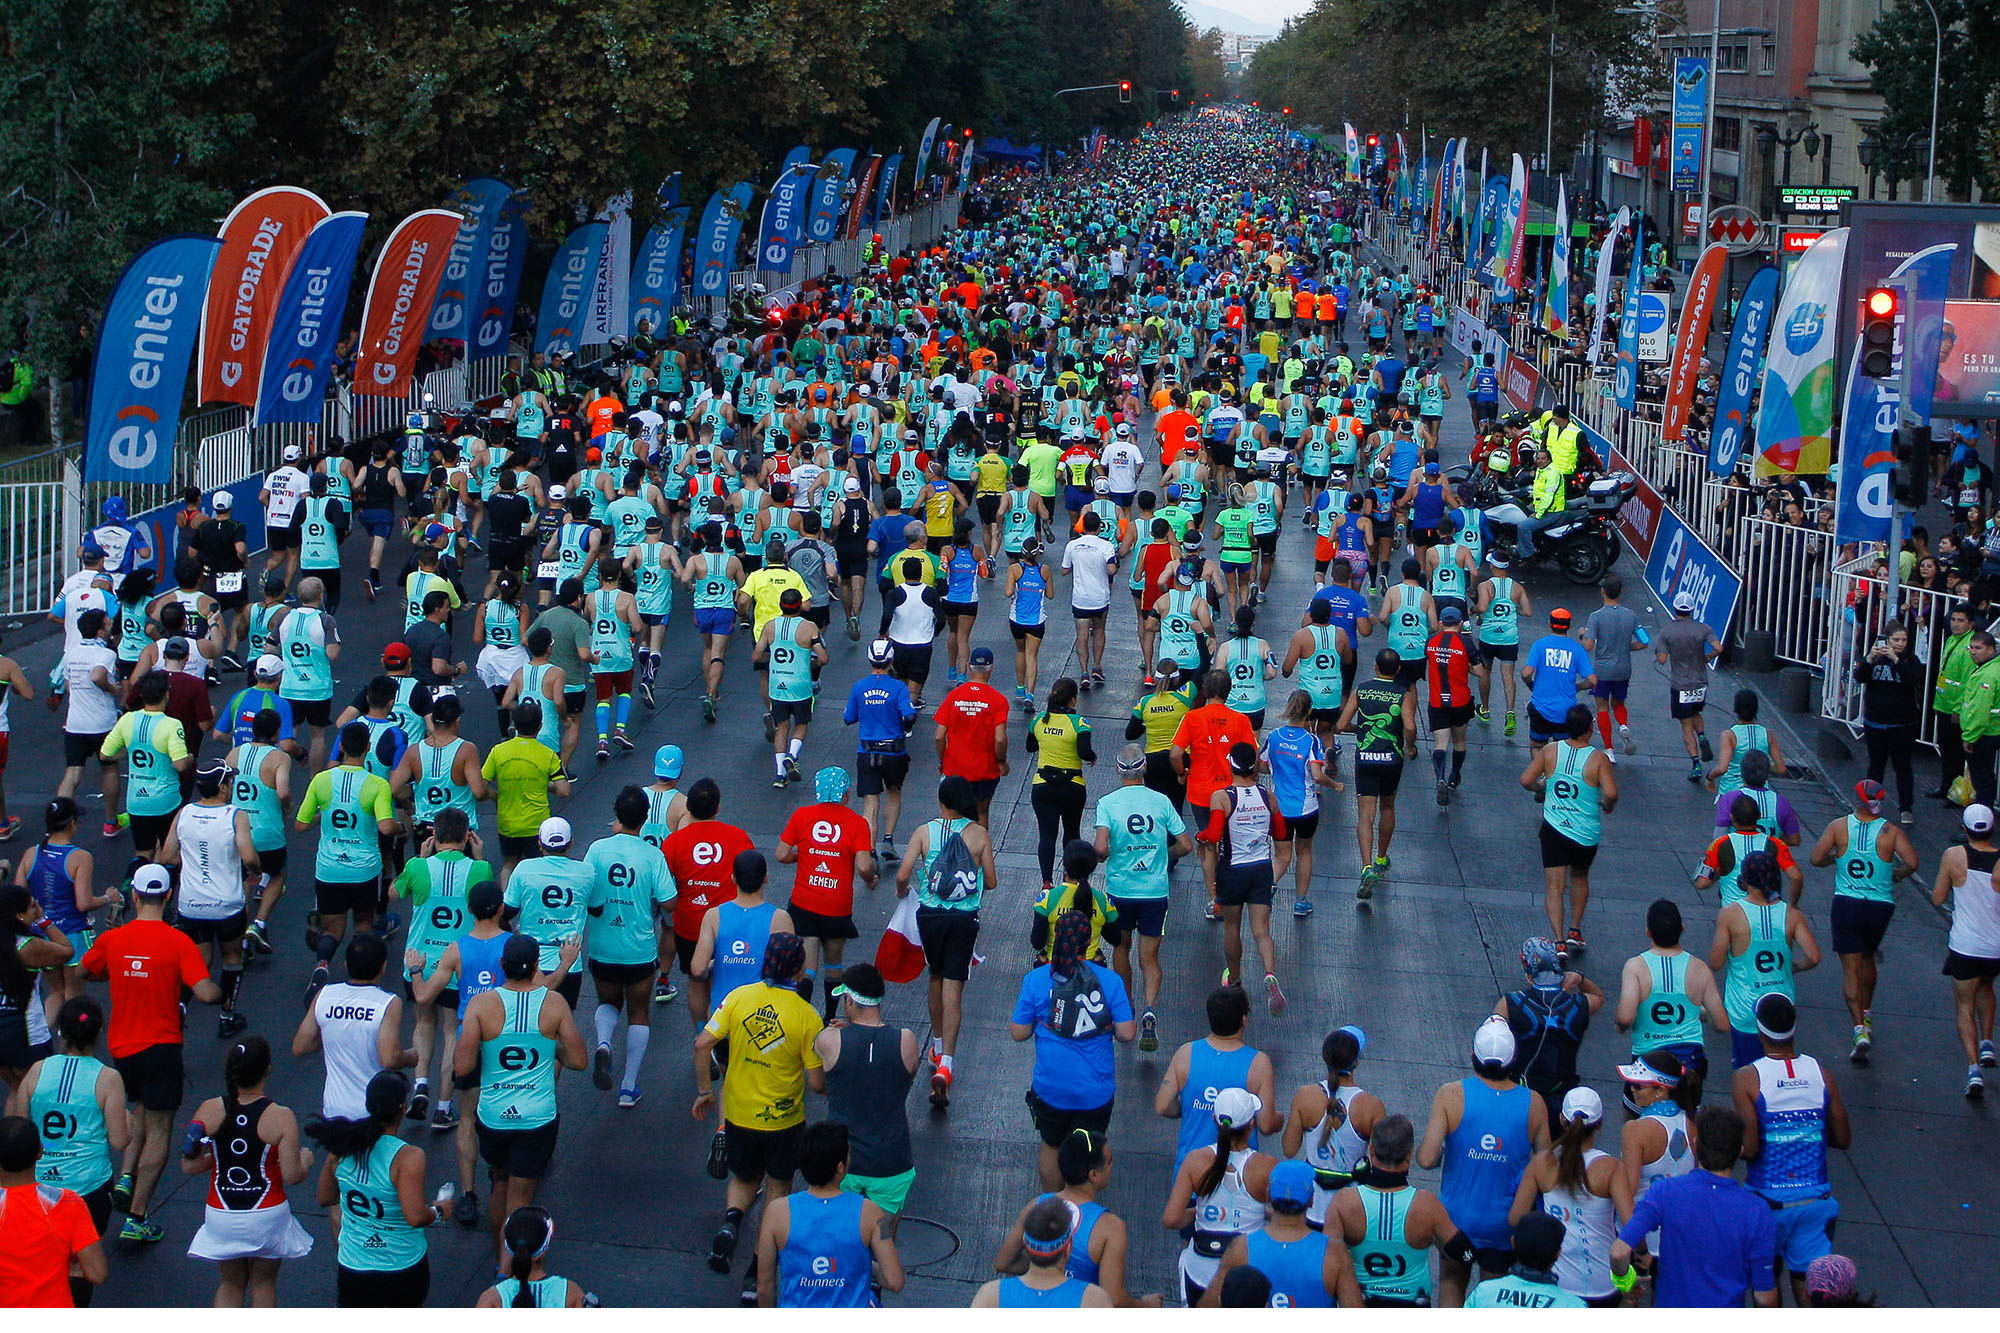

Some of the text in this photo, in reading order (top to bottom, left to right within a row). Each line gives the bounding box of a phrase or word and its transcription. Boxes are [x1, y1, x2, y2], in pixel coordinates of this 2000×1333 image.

[1782, 188, 1852, 196] ESTACION OPERATIVA
[774, 183, 796, 231] entel
[1790, 237, 1802, 247] LA
[487, 223, 512, 298] entel
[229, 216, 284, 352] GATORADE
[558, 246, 590, 319] entel
[384, 239, 429, 355] GATORADE
[296, 265, 332, 348] entel
[129, 273, 185, 389] entel
[1676, 273, 1710, 395] GATORADE
[1735, 299, 1764, 397] entel
[1964, 354, 1995, 364] ES TU
[271, 482, 288, 490] BIKE
[1545, 648, 1573, 669] RUN
[1150, 704, 1175, 714] MANU
[1359, 752, 1393, 762] THULE
[814, 848, 841, 857] GATORADE
[199, 841, 210, 885] RUNNING
[808, 875, 838, 890] REMEDY
[722, 954, 757, 966] Runners
[325, 1004, 375, 1022] JORGE
[756, 1007, 779, 1021] IRON
[501, 1082, 536, 1091] GATORADE
[1467, 1148, 1508, 1163] Runners
[800, 1276, 845, 1288] Runners
